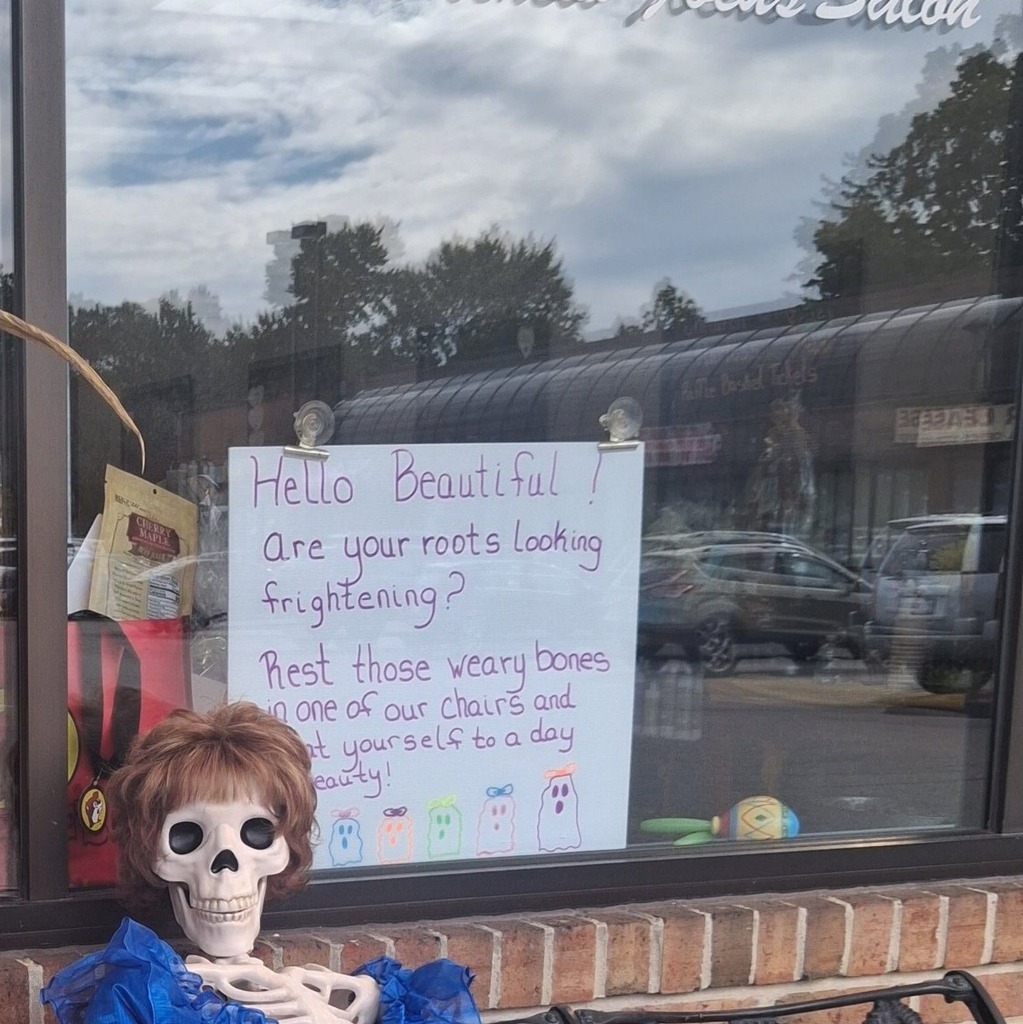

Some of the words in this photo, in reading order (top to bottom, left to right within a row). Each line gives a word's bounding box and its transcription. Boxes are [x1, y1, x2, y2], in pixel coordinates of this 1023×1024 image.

[250, 455, 354, 508] Hello
[391, 448, 559, 502] Beautiful
[136, 516, 173, 538] CHERRY
[139, 527, 171, 547] MAPLE
[336, 536, 410, 587] your
[422, 522, 501, 556] roots
[513, 519, 603, 572] looking
[261, 570, 466, 630] frightening?
[258, 642, 334, 690] Rest
[352, 643, 432, 684] those
[447, 652, 526, 694] weary
[534, 640, 611, 673] bones
[295, 699, 338, 723] one
[346, 690, 378, 720] of
[384, 701, 428, 722] our
[440, 686, 525, 720] chairs
[533, 682, 577, 712] and
[341, 724, 464, 774] yourself
[471, 726, 496, 750] to
[504, 732, 522, 747] a
[530, 716, 575, 754] day
[313, 760, 391, 799] eauty!
